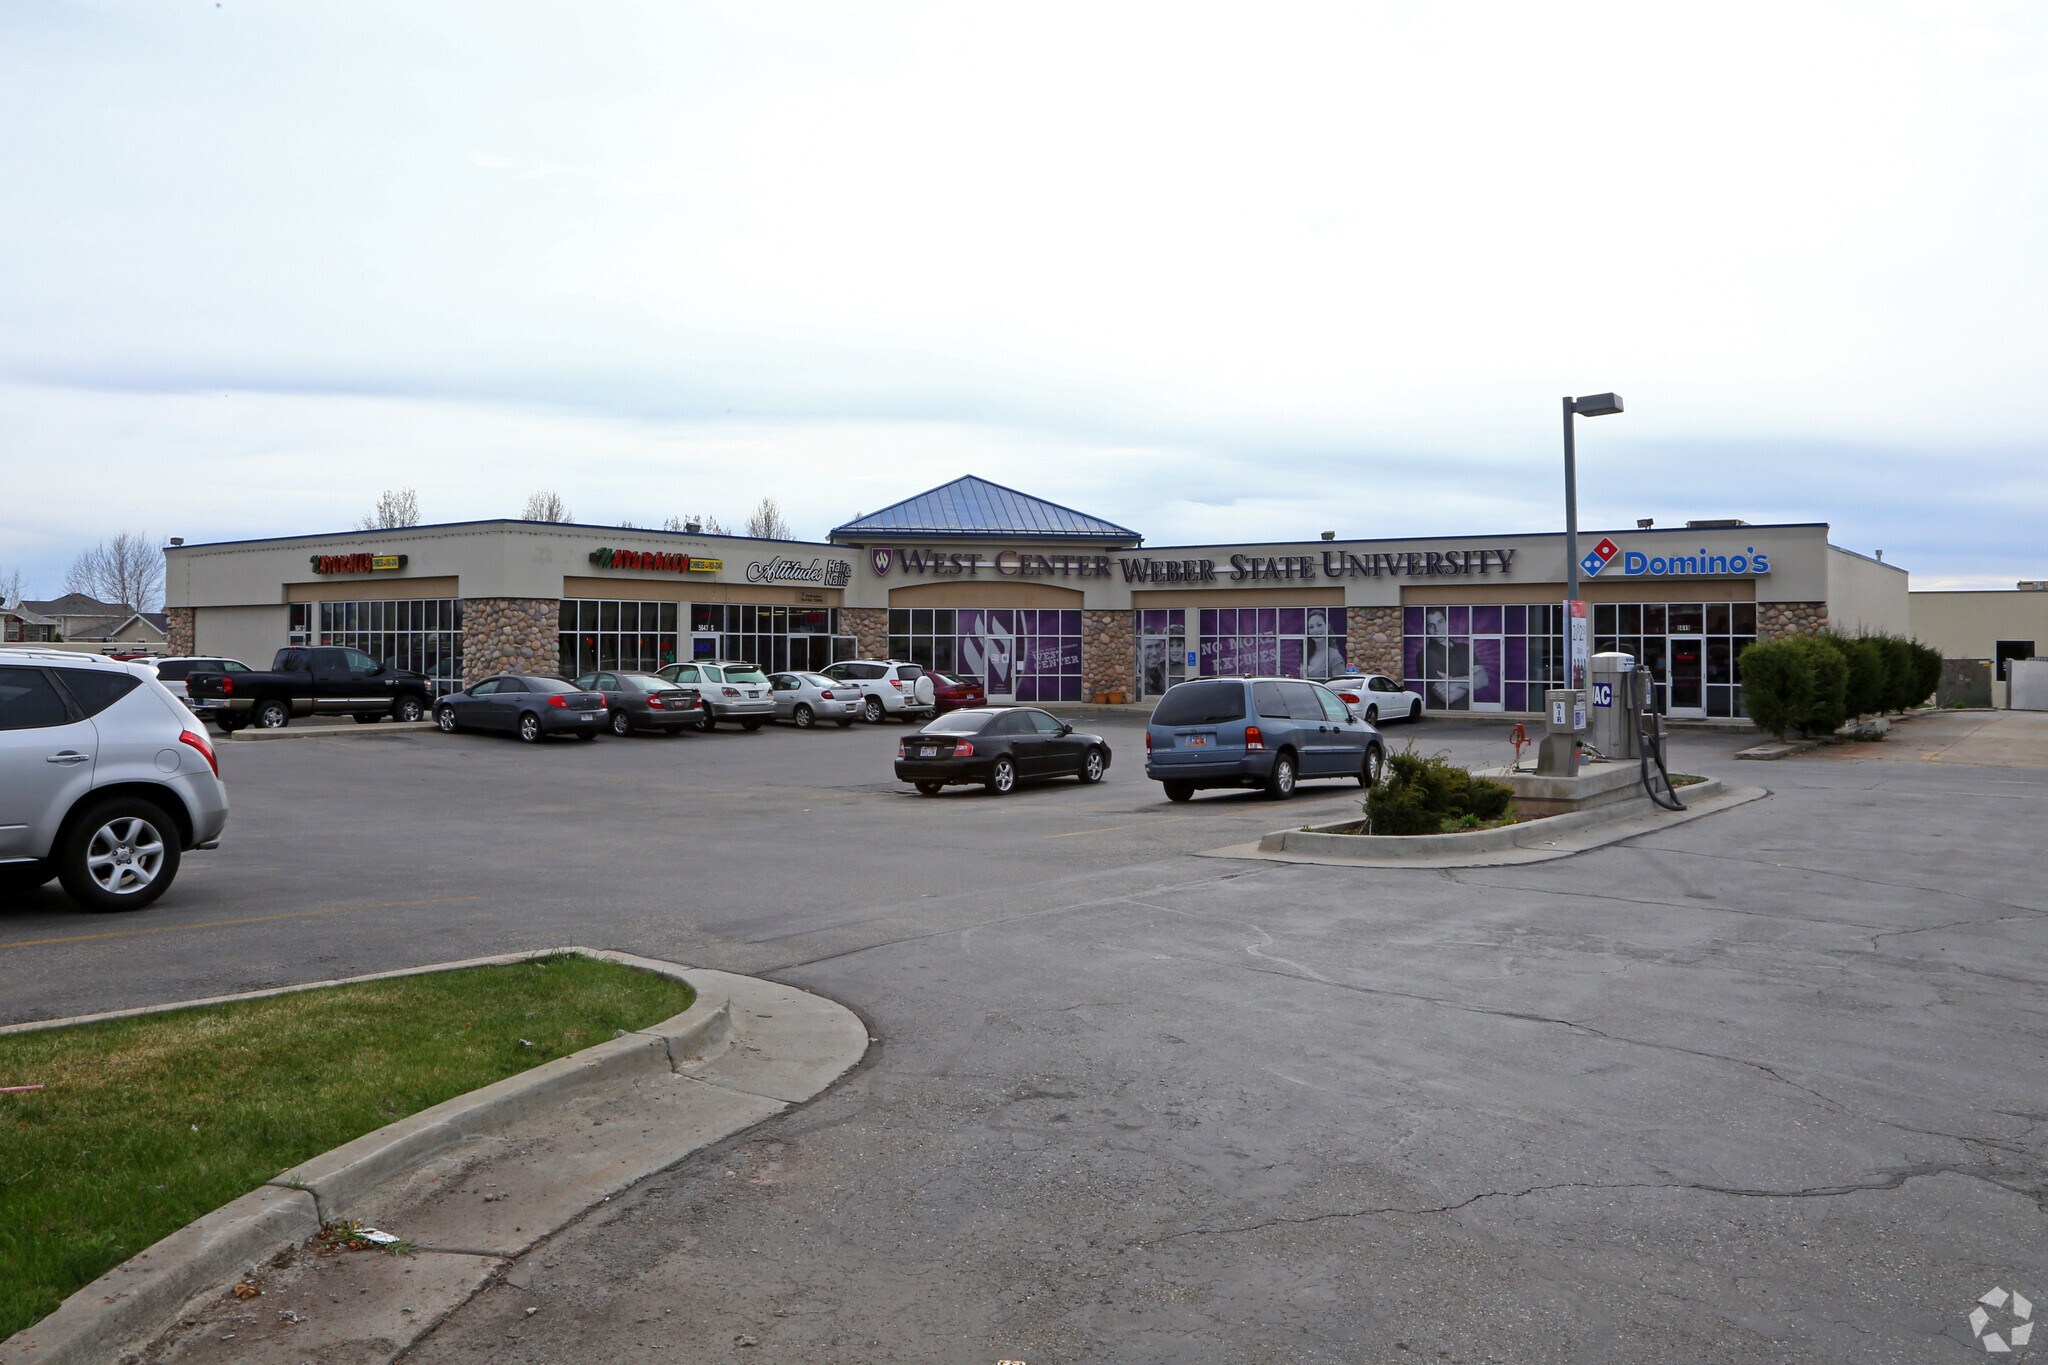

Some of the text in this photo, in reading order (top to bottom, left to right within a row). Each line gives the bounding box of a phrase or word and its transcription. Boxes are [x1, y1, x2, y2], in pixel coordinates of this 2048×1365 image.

[747, 556, 823, 583] Attitudes
[827, 559, 847, 574] Hair
[898, 549, 1111, 576] WEST CENTER
[1118, 549, 1516, 583] WEBER STATE UNIVERSITY
[1624, 546, 1769, 576] Domino's
[824, 572, 849, 587] Nails
[1201, 641, 1222, 655] NO
[1034, 655, 1079, 670] CENTER
[1592, 685, 1611, 705] AC
